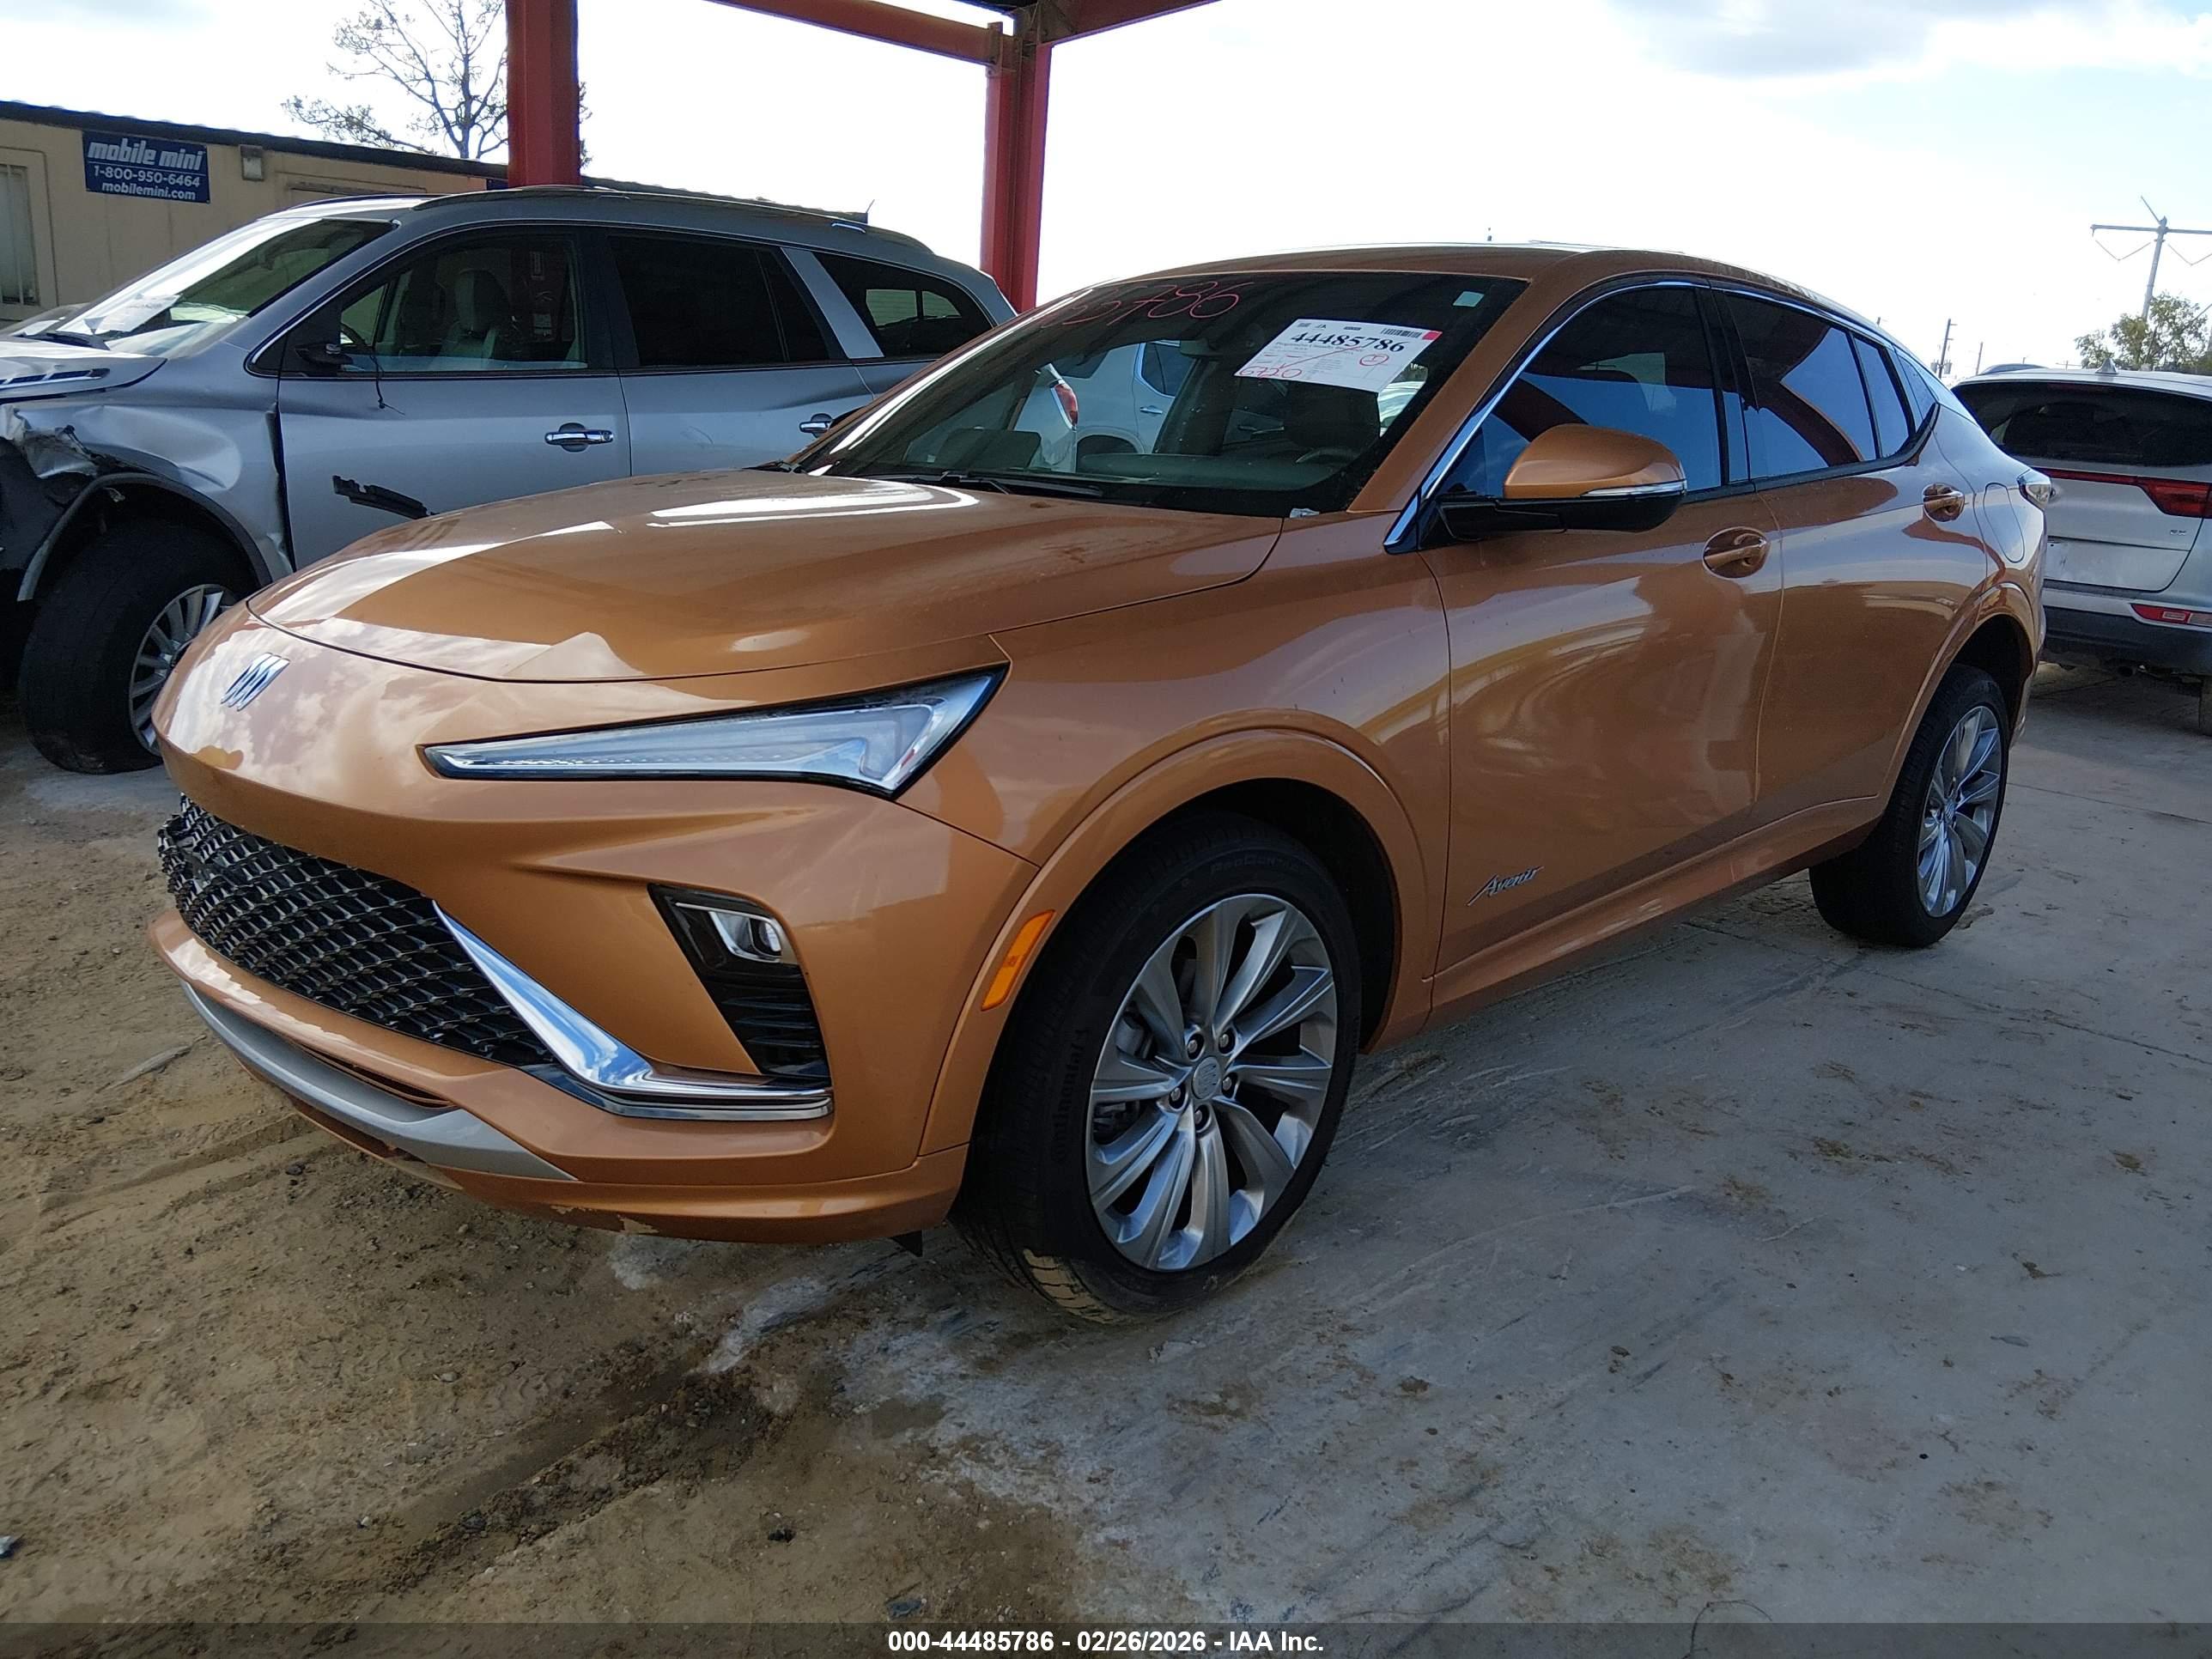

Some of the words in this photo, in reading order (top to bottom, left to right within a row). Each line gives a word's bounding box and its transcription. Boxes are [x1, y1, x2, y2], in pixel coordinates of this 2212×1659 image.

[88, 137, 156, 165] mobile
[159, 148, 204, 170] mini
[94, 165, 200, 187] 1-800-950-6464
[101, 182, 196, 200] mobilemini.com
[1291, 331, 1409, 352] 44485786
[1465, 866, 1544, 907] Avenir
